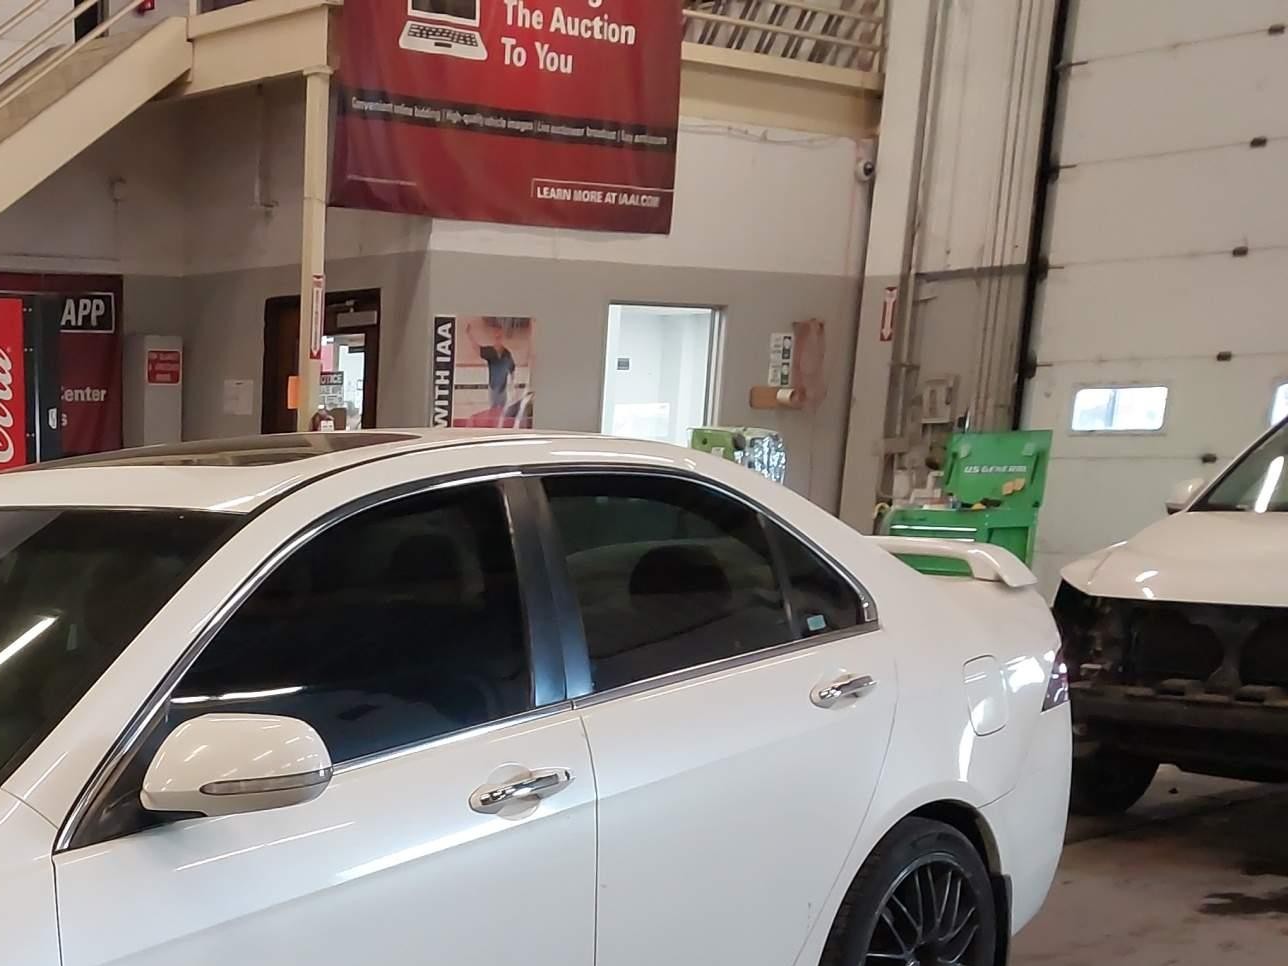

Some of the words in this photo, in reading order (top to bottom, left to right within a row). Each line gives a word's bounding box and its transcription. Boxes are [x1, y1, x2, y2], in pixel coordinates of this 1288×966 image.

[504, 0, 543, 30] The
[550, 7, 636, 45] Auction
[501, 37, 527, 67] To
[535, 42, 573, 74] You
[536, 186, 571, 200] LEARN
[573, 190, 602, 203] MORE
[604, 192, 617, 204] AT
[60, 298, 105, 326] APP
[436, 322, 453, 362] IAA
[61, 386, 107, 402] enter
[320, 373, 343, 385] OTICE
[433, 369, 450, 428] WITH
